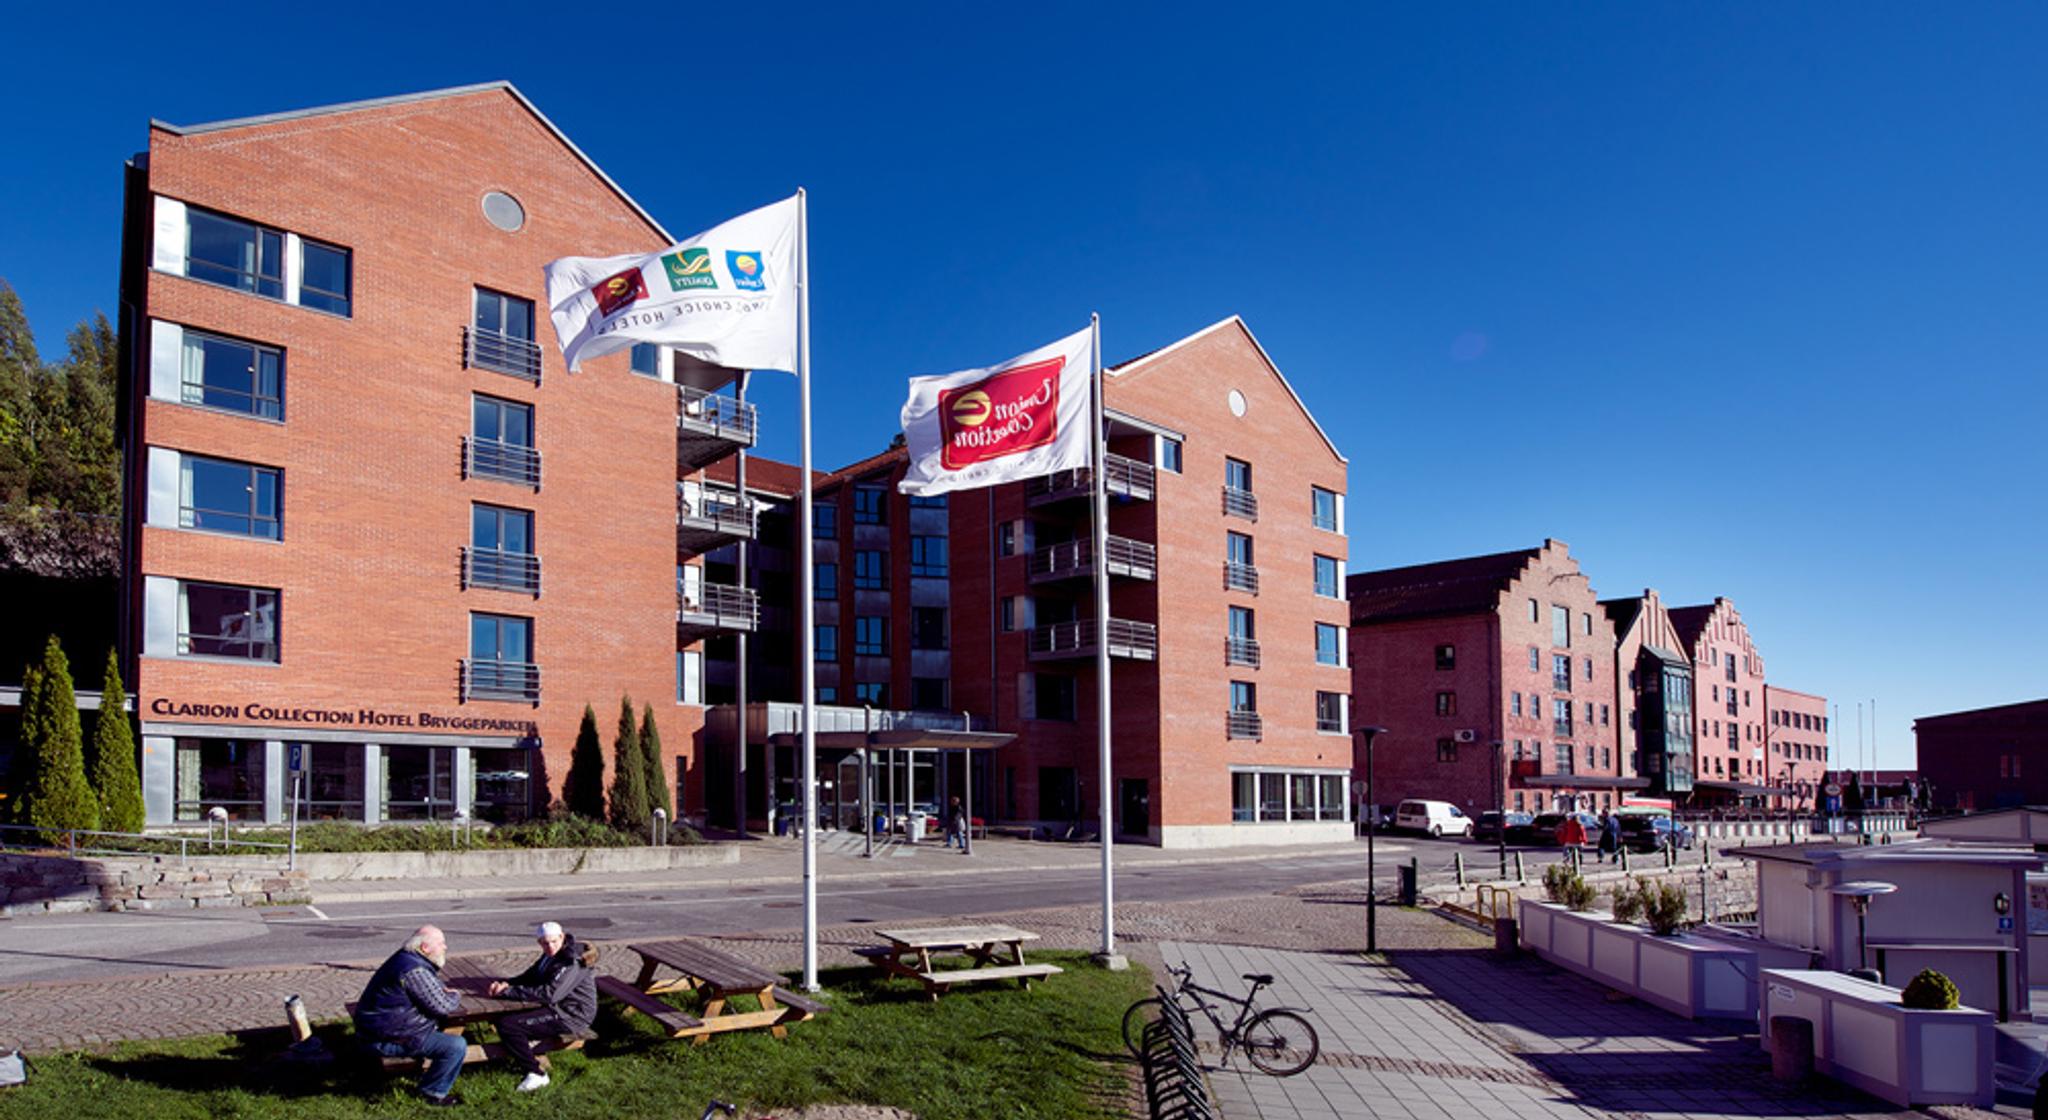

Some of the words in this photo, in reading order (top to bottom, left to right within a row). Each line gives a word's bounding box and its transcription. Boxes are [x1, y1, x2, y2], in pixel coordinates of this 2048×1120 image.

[151, 698, 239, 718] CLARION
[244, 704, 354, 724] COLLECTION
[358, 709, 414, 727] HOTEL
[418, 712, 537, 733] BRYGGEPARKEN
